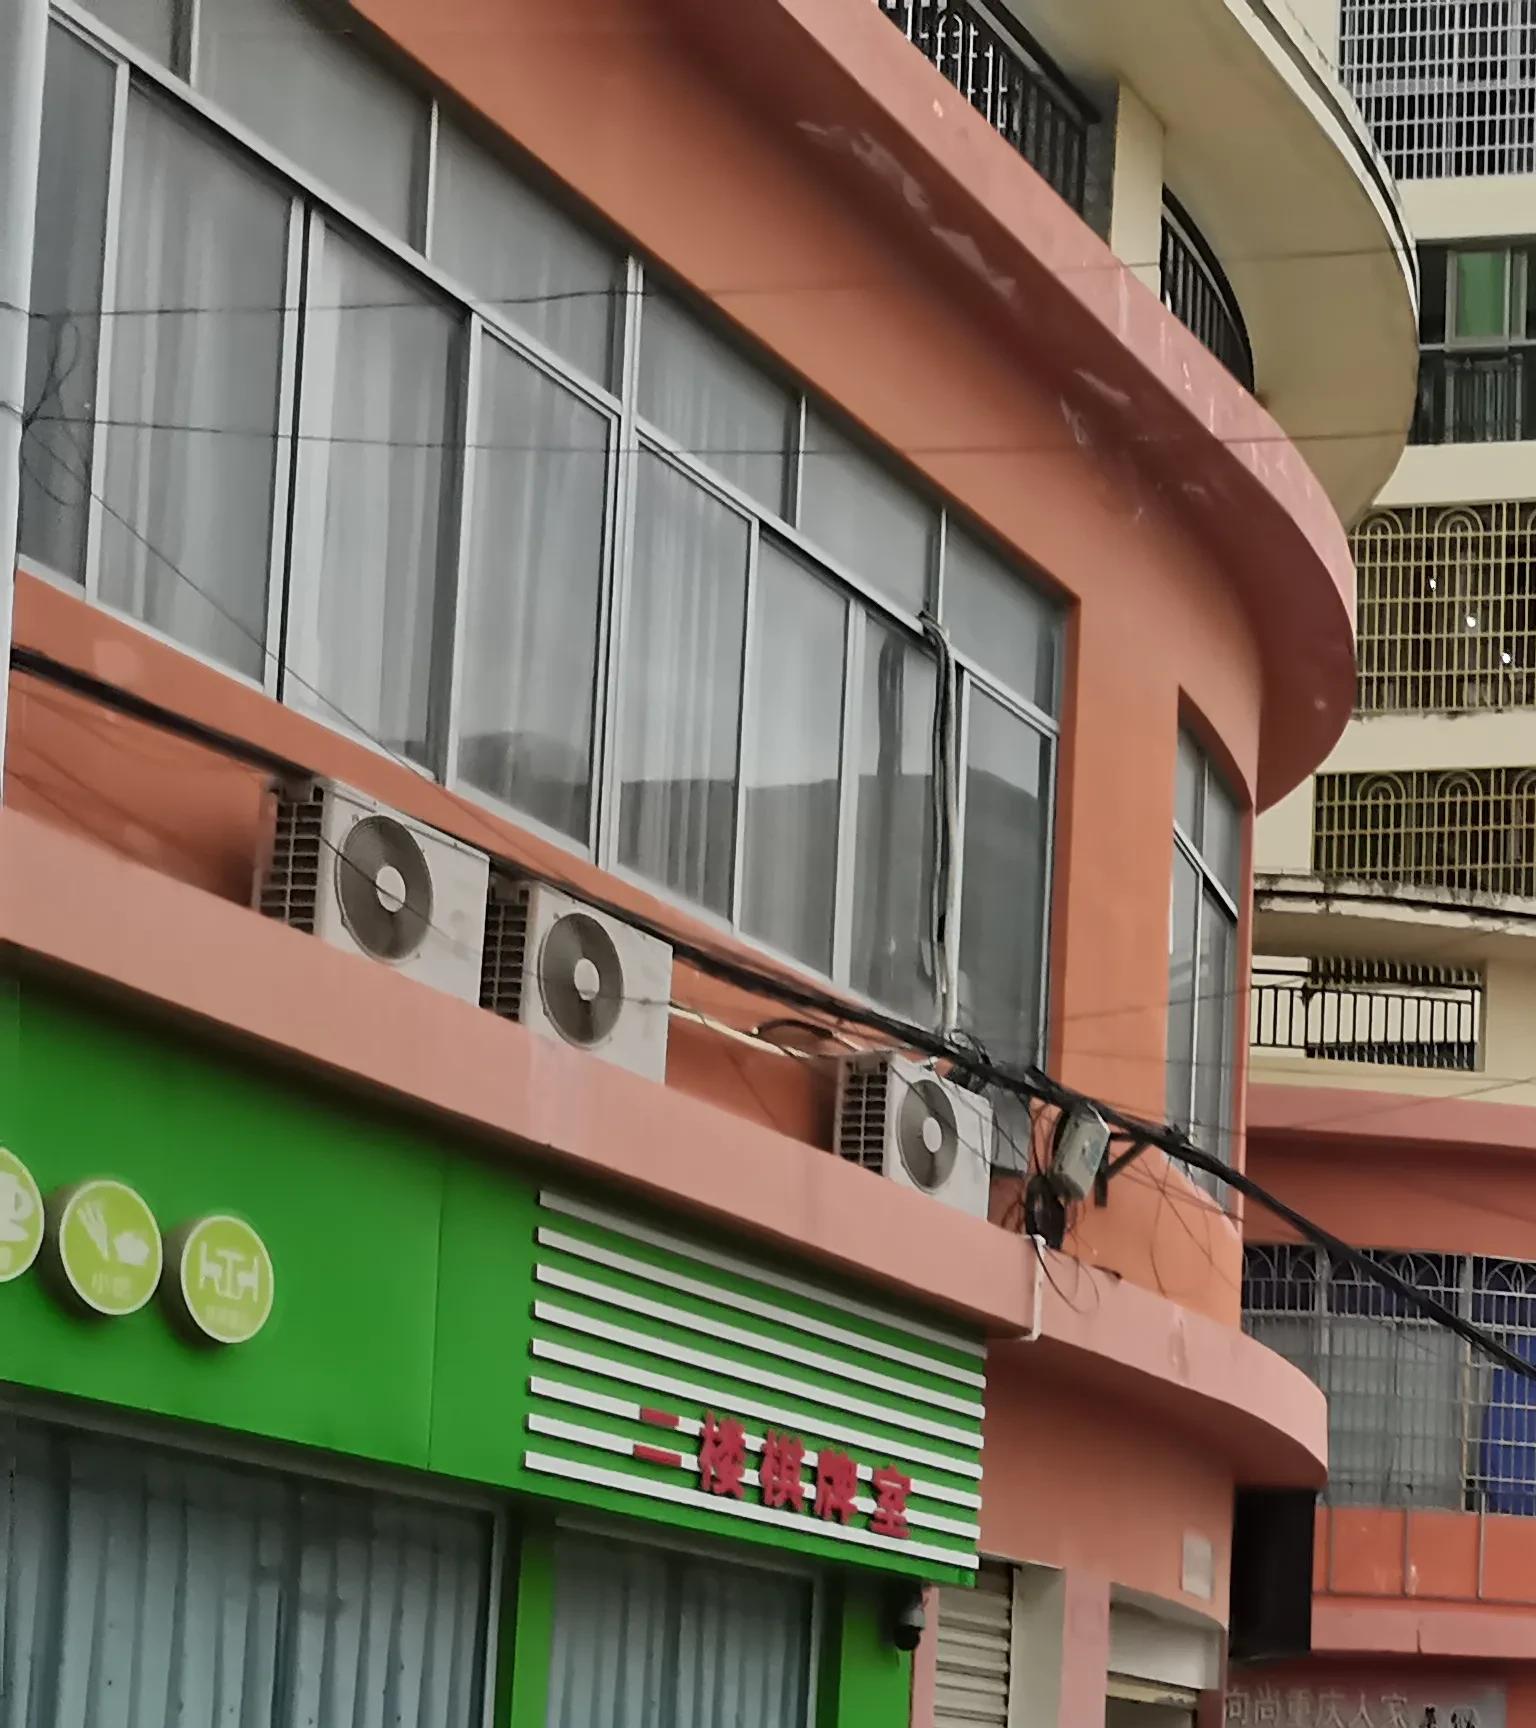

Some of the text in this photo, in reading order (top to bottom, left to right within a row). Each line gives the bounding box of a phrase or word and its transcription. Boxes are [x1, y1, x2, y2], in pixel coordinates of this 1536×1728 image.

[632, 1408, 912, 1540] 二楼棋牌室
